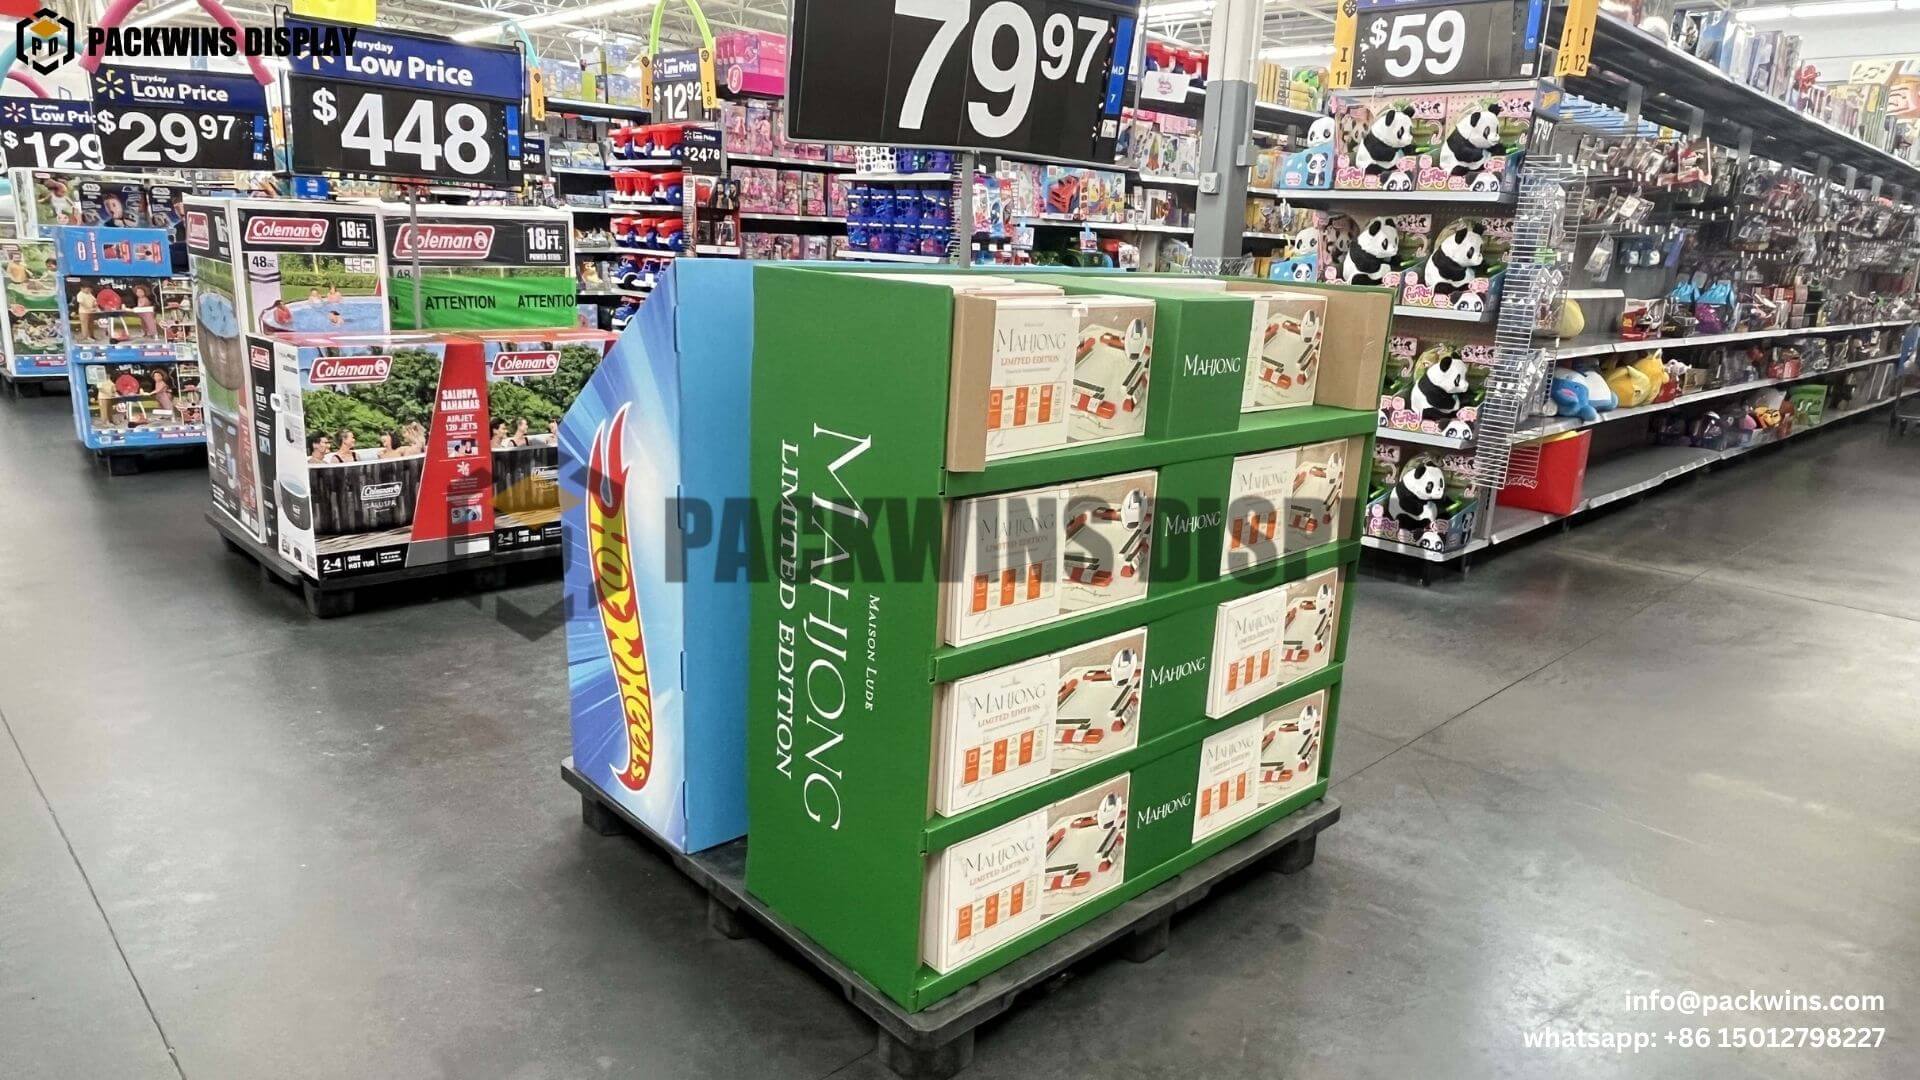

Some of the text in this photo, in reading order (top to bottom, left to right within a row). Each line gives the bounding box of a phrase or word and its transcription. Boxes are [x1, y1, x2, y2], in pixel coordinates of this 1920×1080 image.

[352, 40, 393, 54] veryday
[1368, 10, 1466, 78] $59
[345, 52, 473, 87] Low Price
[131, 81, 229, 102] Low Price
[31, 108, 65, 121] Low
[312, 87, 491, 175] $448
[252, 220, 310, 238] Coleman
[527, 227, 546, 250] 18
[252, 255, 267, 269] 48
[425, 293, 577, 310] ATTENTION ATTENTIO
[996, 328, 1067, 354] MAHJONG
[316, 360, 374, 378] Coleman
[497, 355, 546, 370] Coleman
[1183, 354, 1241, 377] MAHJONG
[980, 512, 1054, 541] MAHJONG
[1164, 511, 1221, 537] MAHJONG
[776, 439, 799, 780] LIMITED EDITION
[802, 422, 872, 831] MAHJONG
[1150, 656, 1206, 689] MAHJONG
[972, 683, 1047, 718] MAHJONG
[1136, 792, 1192, 830] MAHJONG
[963, 837, 1035, 877] MAHJONG
